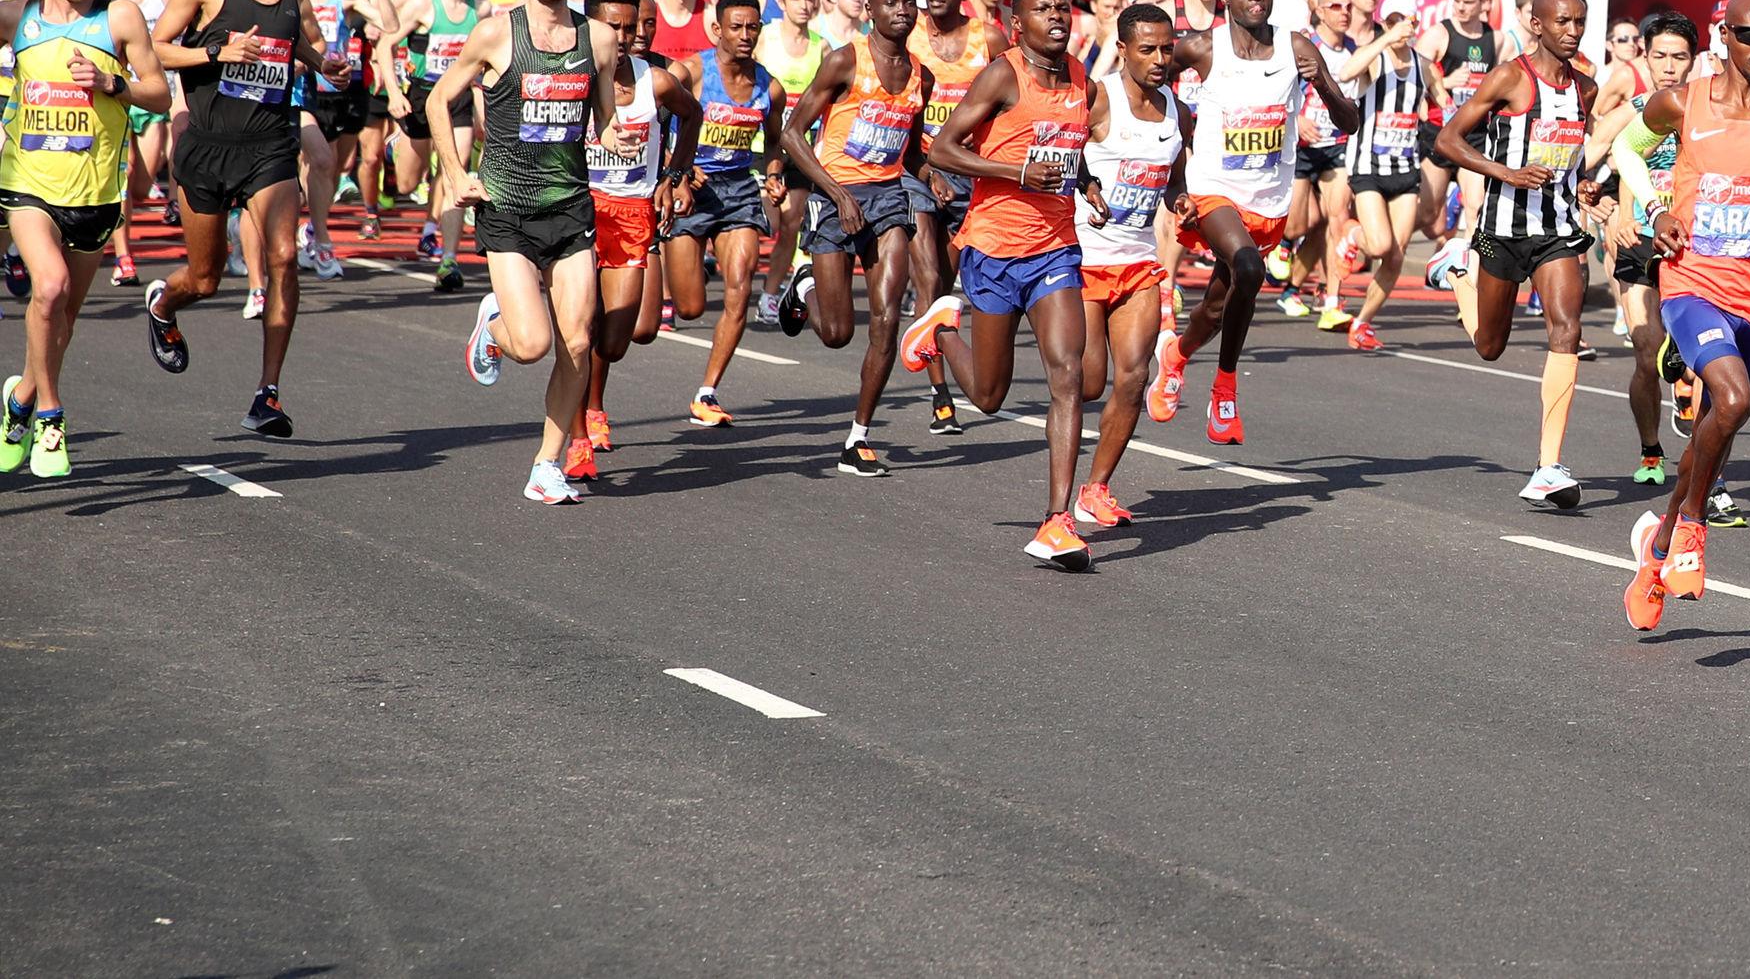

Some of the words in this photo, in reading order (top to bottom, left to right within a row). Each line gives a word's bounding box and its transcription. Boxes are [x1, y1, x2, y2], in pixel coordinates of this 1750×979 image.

[1466, 61, 1489, 73] RMY
[226, 62, 284, 86] CABADA
[553, 81, 588, 93] money
[940, 89, 968, 97] mone
[52, 87, 89, 101] money
[523, 100, 583, 123] OLEFIRENKO
[886, 110, 912, 122] money
[1252, 110, 1284, 122] money
[24, 109, 89, 132] MELLOR
[853, 120, 910, 150] WANJIRU
[1058, 130, 1085, 142] money
[1560, 128, 1583, 138] money
[1225, 128, 1284, 152] KIRUI
